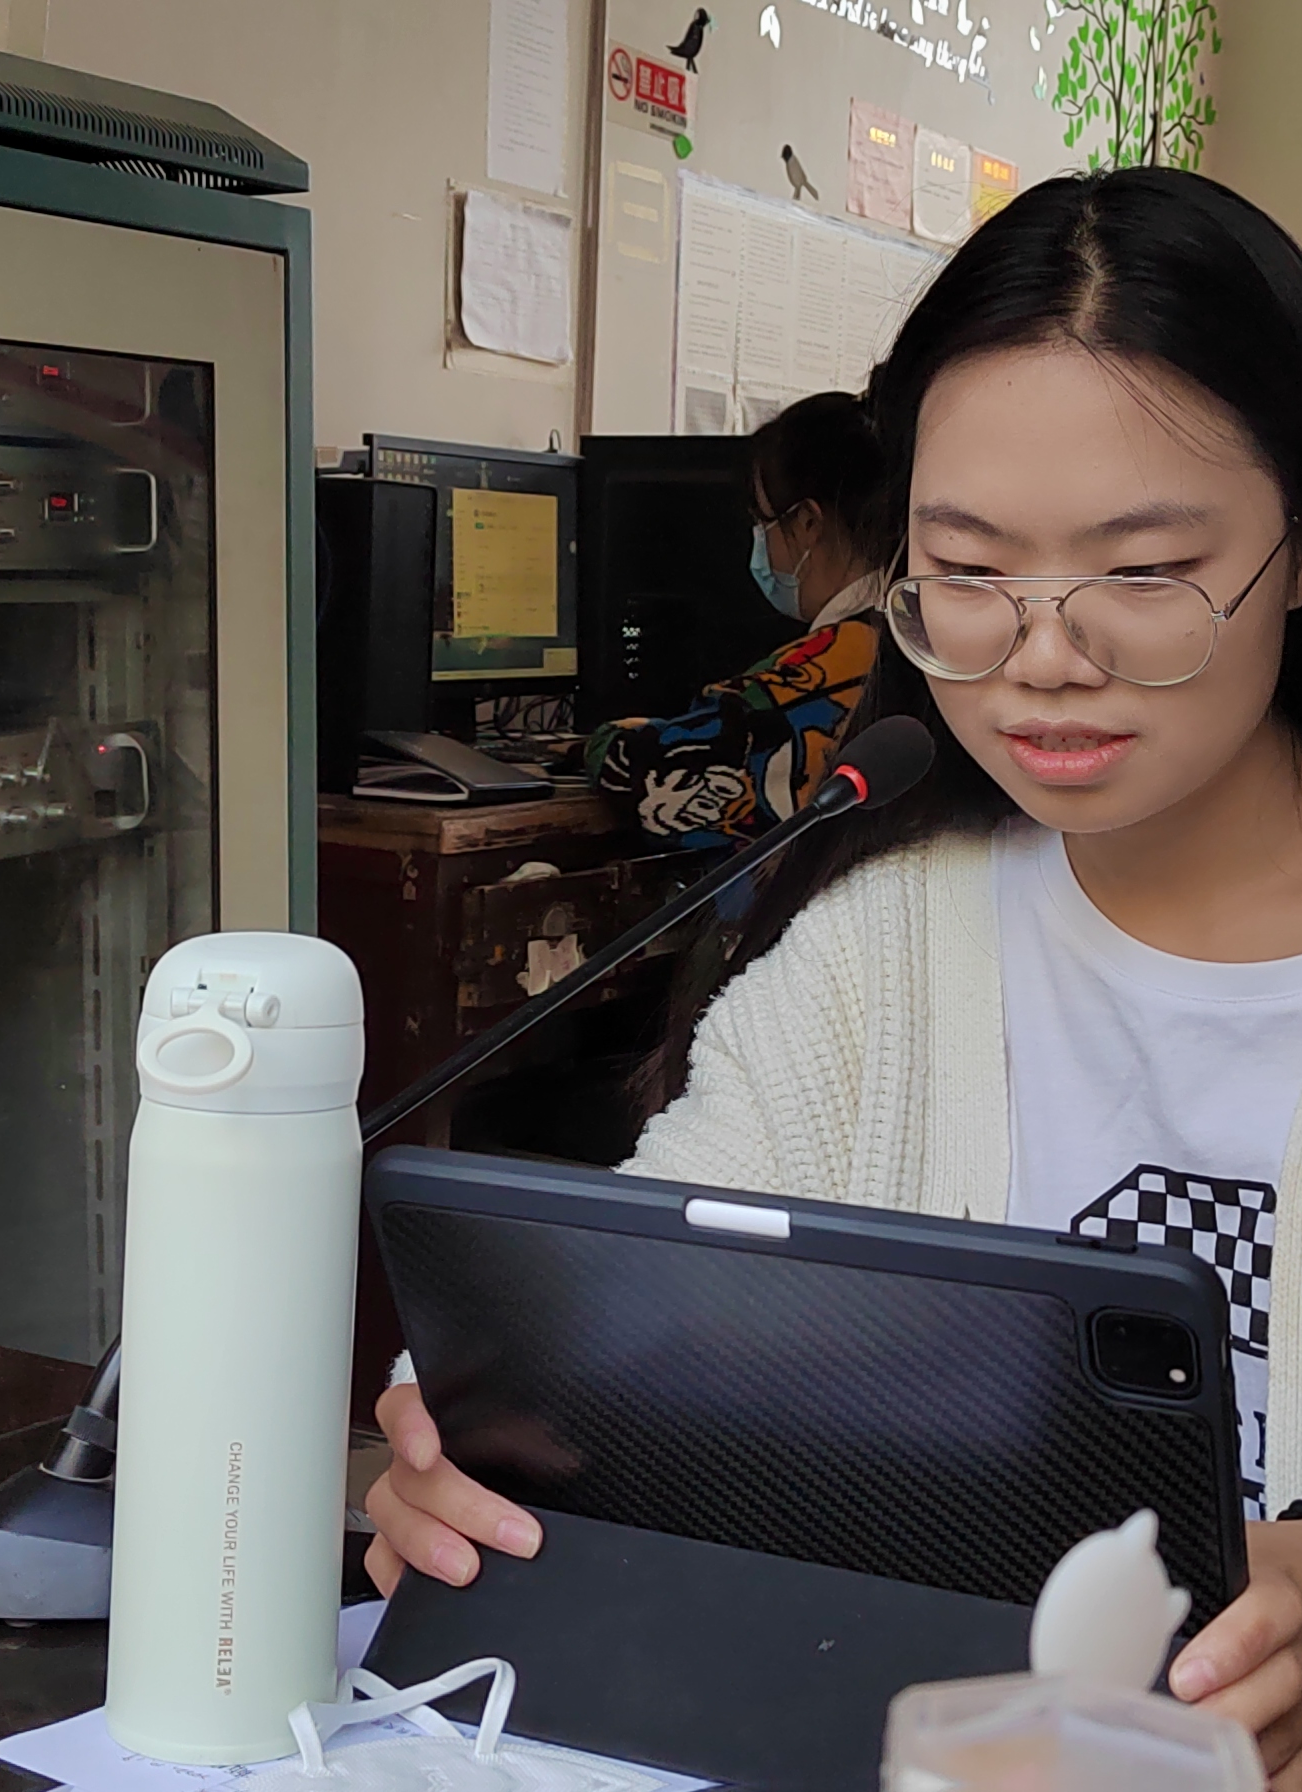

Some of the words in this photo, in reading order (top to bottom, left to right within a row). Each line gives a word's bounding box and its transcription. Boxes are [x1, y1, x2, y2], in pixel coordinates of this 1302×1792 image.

[638, 64, 686, 107] 禁止吸
[634, 98, 649, 114] NO
[650, 104, 687, 129] SMOKIN
[226, 1441, 243, 1506] CHANGE
[223, 1509, 239, 1551] YOUR
[221, 1556, 236, 1588] LIFE
[218, 1590, 234, 1630] WITH
